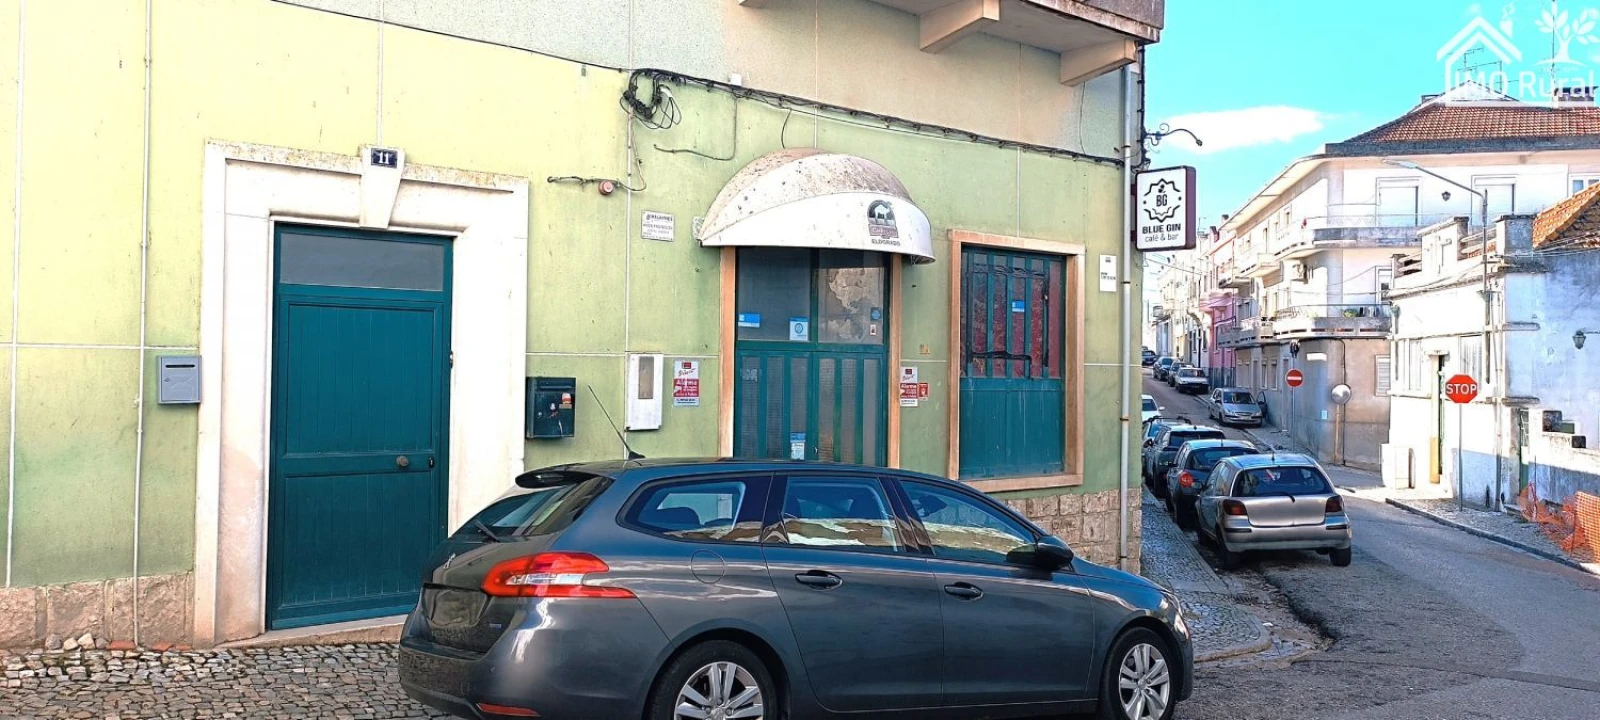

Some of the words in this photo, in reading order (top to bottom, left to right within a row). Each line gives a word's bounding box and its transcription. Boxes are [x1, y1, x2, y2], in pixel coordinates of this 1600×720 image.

[378, 151, 390, 164] 11
[1156, 194, 1168, 207] BG
[1142, 224, 1164, 235] BLUE
[1166, 223, 1181, 232] GIN
[871, 238, 901, 246] ELDORADO
[1145, 234, 1158, 243] café
[1160, 233, 1166, 241] &
[1167, 233, 1179, 241] bar
[1446, 383, 1477, 395] STOP
